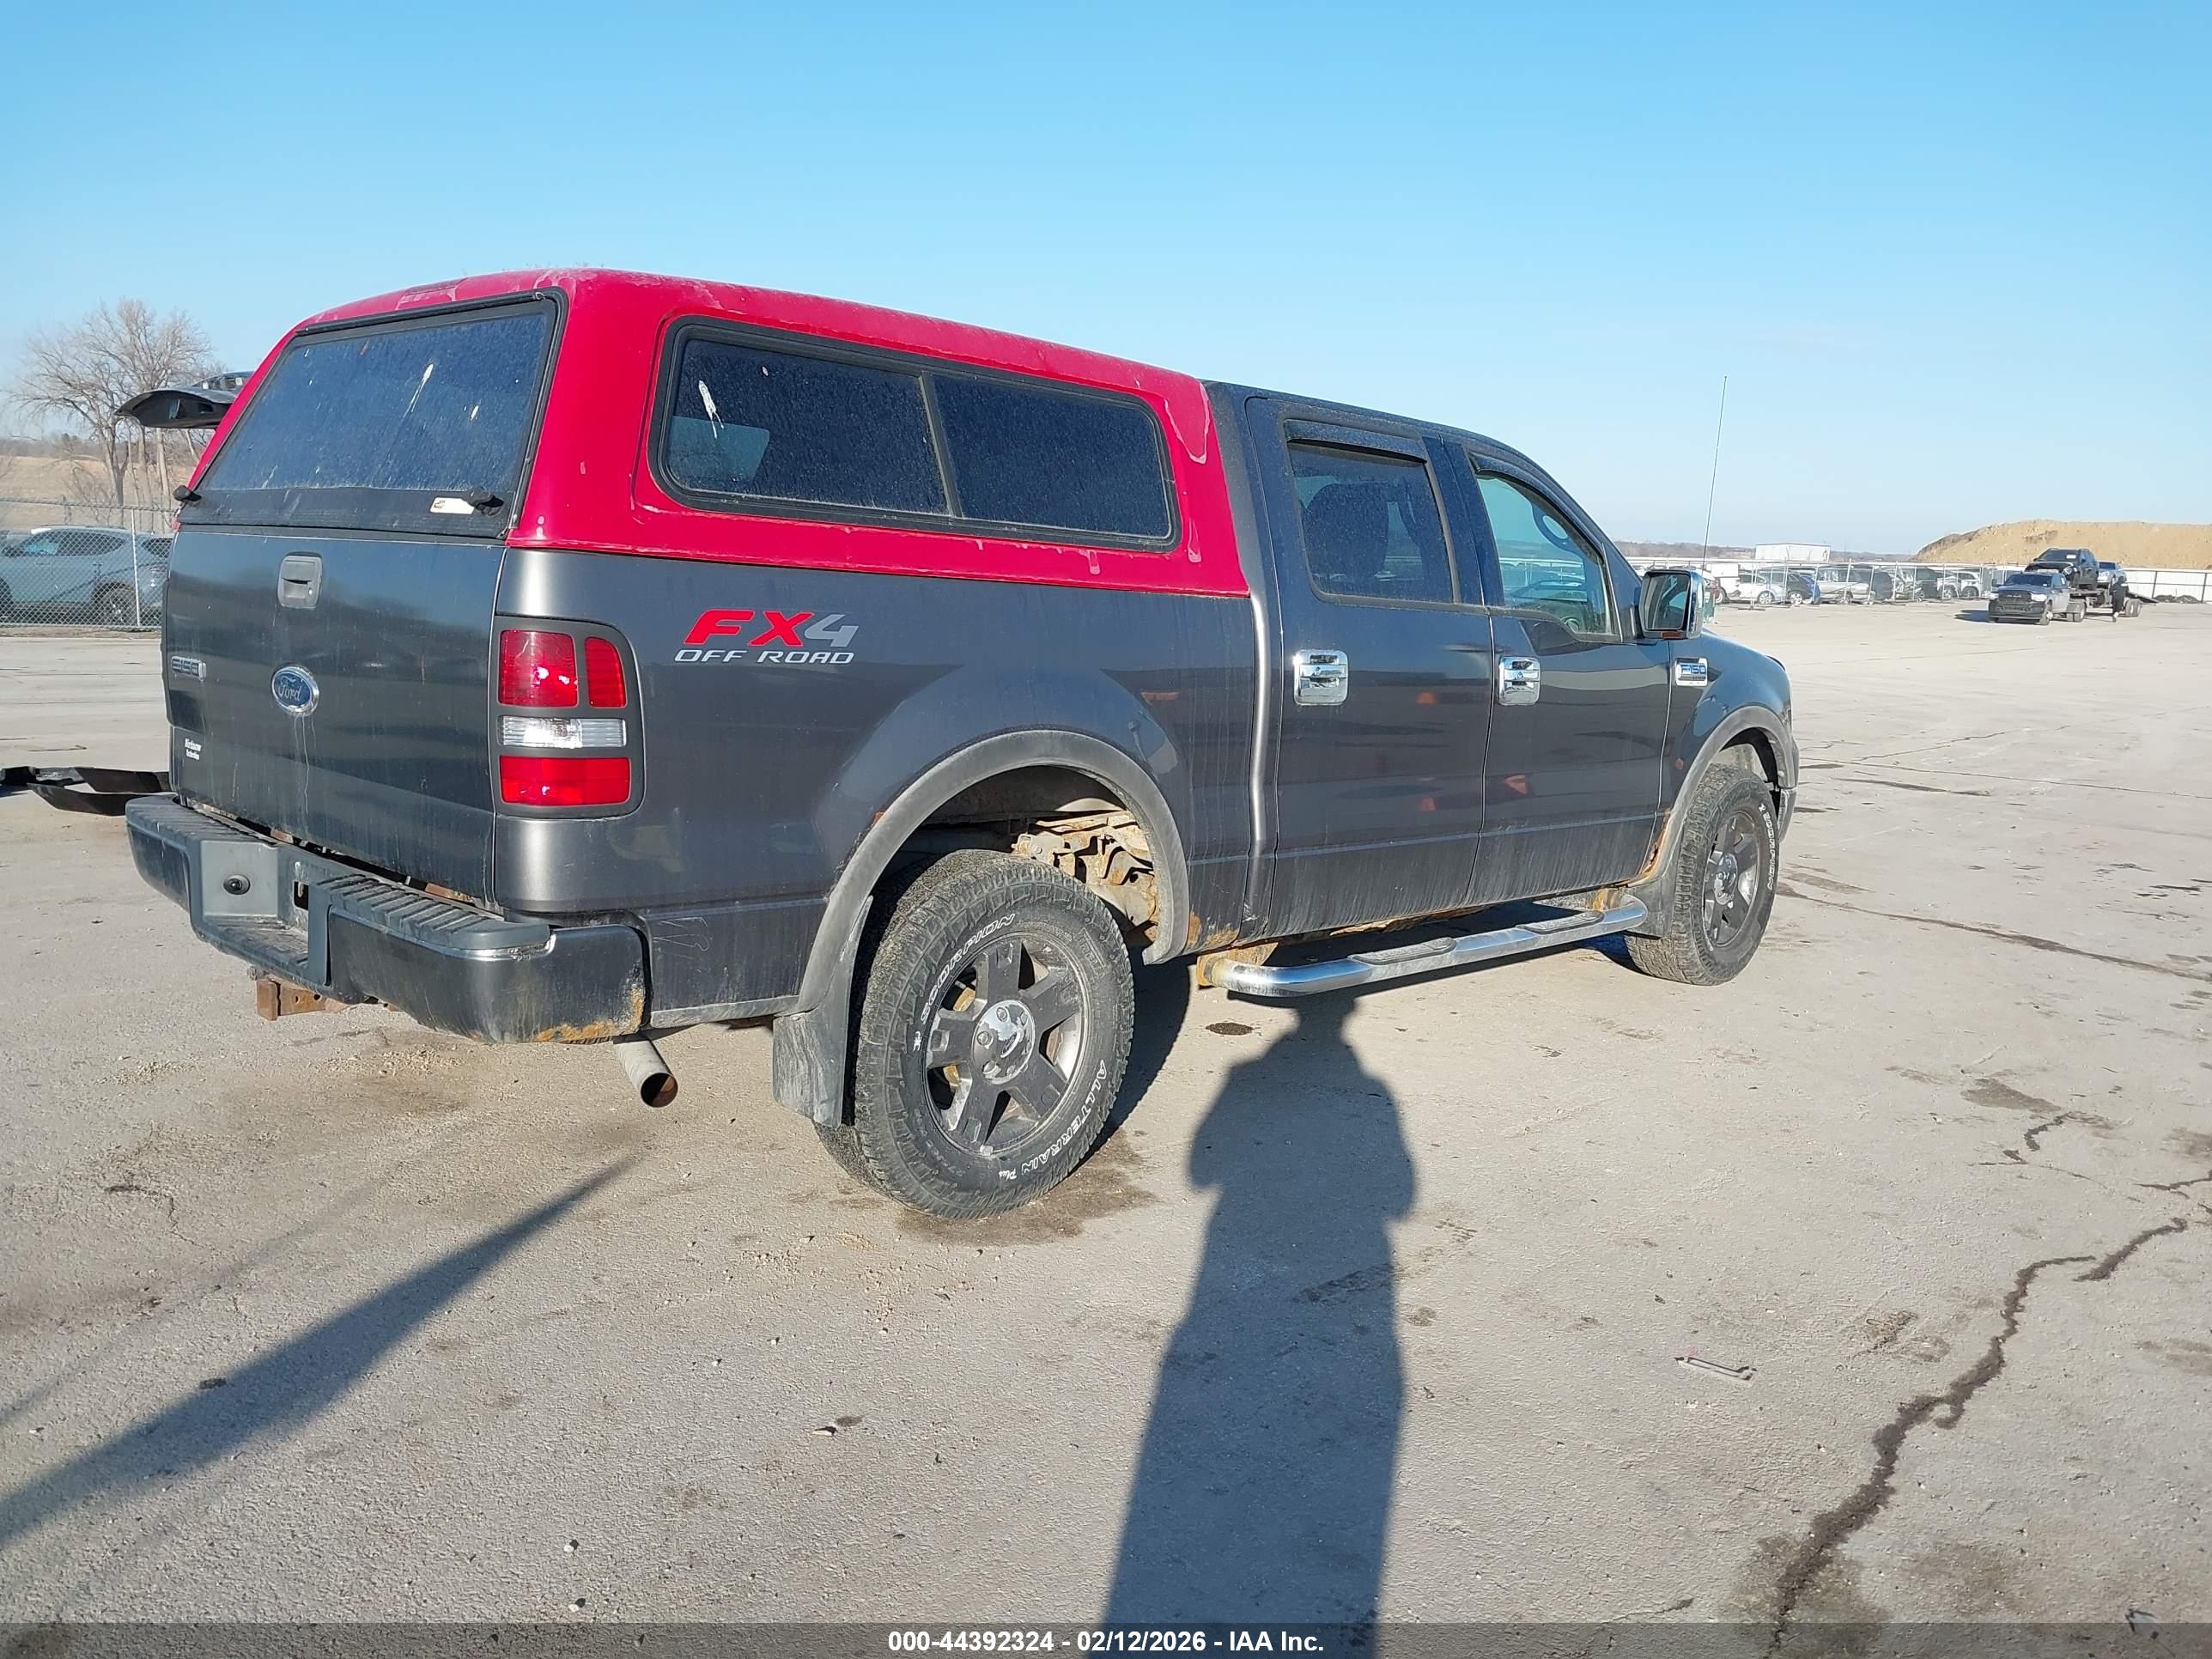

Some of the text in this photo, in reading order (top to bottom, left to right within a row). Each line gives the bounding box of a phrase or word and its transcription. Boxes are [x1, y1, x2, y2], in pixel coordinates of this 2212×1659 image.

[683, 608, 860, 647] FX4
[674, 648, 854, 665] OFF ROAD
[278, 675, 302, 702] Ford
[921, 914, 1015, 1024] SCORPION
